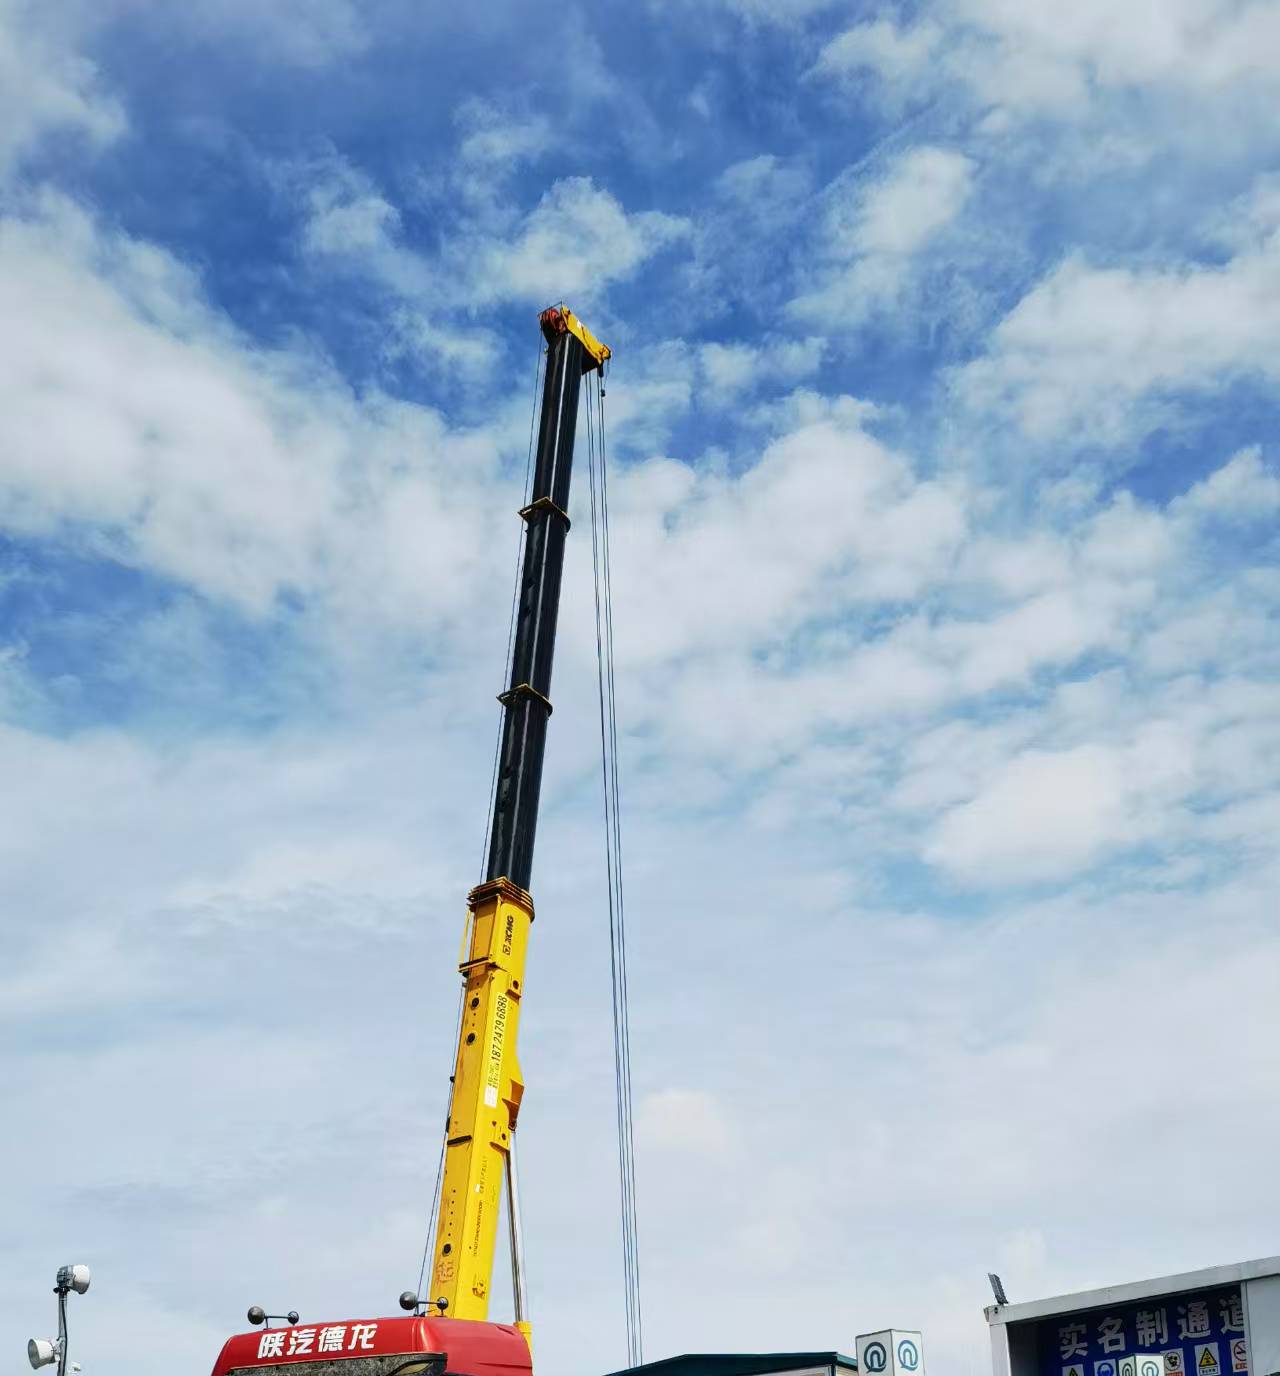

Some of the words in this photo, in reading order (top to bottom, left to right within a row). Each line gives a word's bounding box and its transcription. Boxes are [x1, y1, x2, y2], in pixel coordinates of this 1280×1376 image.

[504, 915, 514, 946] XCMG
[496, 995, 508, 1020] 6888
[257, 1323, 378, 1359] 陕汽德龙
[1059, 1295, 1246, 1360] 实名制通道
